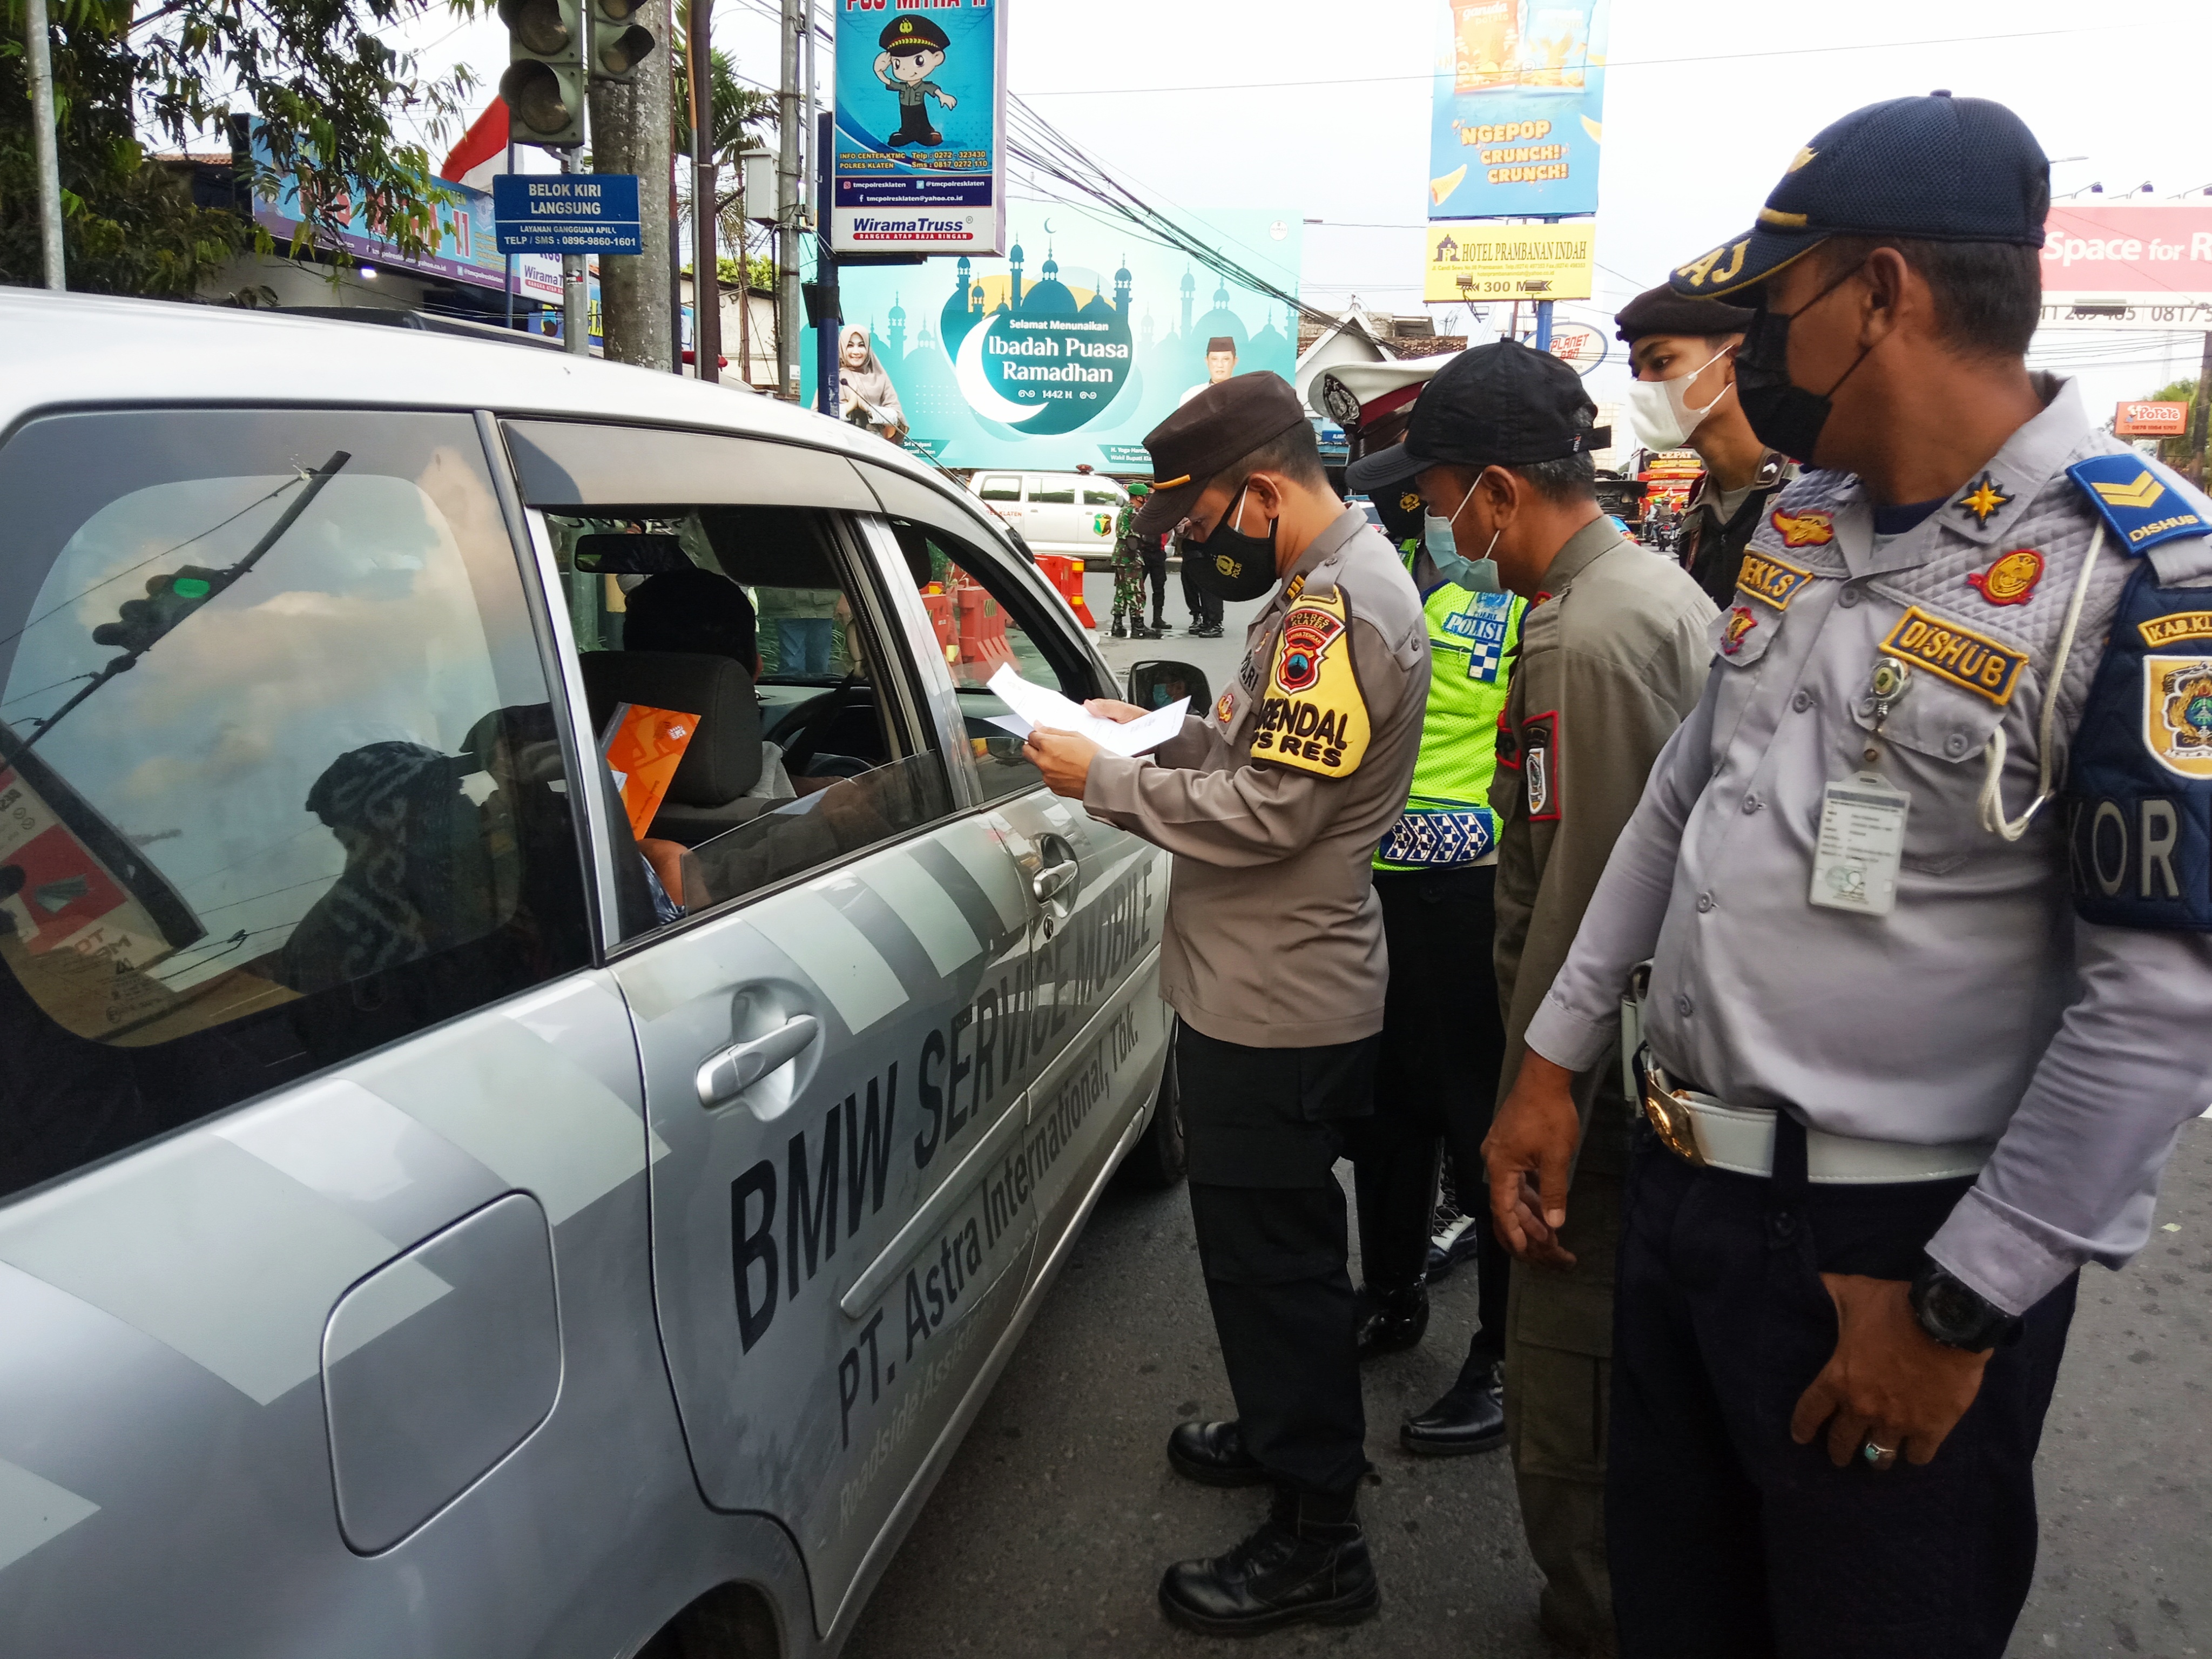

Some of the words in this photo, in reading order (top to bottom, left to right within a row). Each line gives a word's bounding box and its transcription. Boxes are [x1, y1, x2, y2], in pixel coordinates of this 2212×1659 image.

[1462, 2, 1508, 21] garuda
[1475, 13, 1509, 26] potato
[1461, 119, 1551, 145] NGEPOP
[1480, 144, 1562, 165] CRUNCH!
[1487, 163, 1569, 184] CRUNCH!
[529, 184, 571, 197] BELOK
[575, 184, 601, 197] KIRI
[531, 202, 601, 214] LANGSUNG
[854, 218, 963, 232] WiramaTruss
[504, 237, 527, 245] TELP
[535, 236, 554, 244] SMS
[562, 237, 636, 246] 0896-9860-1601
[2043, 231, 2142, 267] Space
[2148, 239, 2184, 261] for
[1462, 243, 1493, 261] HOTEL
[1495, 242, 1554, 261] PRAMBANAN
[1555, 241, 1587, 260] INDAH
[524, 265, 564, 286] WiramaT
[1484, 281, 1510, 292] 300
[1009, 319, 1048, 329] Selamat
[1050, 321, 1109, 331] Menunaikan
[988, 335, 1058, 356] Ibadah
[1065, 338, 1128, 358] Puasa
[1551, 334, 1589, 352] PLANET
[1002, 361, 1113, 382] Ramadhan
[1042, 390, 1062, 399] 1442
[1065, 390, 1073, 399] H
[1658, 451, 1693, 459] CEPAT
[2129, 515, 2200, 542] DISHUB
[1231, 563, 1242, 578] POLRI
[1291, 613, 1330, 626] POLRES
[1292, 619, 1325, 630] KLATEN
[1445, 615, 1504, 641] POLISI
[1899, 621, 2007, 687] DISHUB
[731, 1060, 898, 1356] BMW
[914, 935, 1070, 1170] SERVICE
[1076, 866, 1153, 1010] MOBILE
[839, 1307, 895, 1452] PT.
[905, 1217, 982, 1363] Astra
[982, 1050, 1111, 1249] International,
[1111, 1008, 1139, 1074] Tbk.
